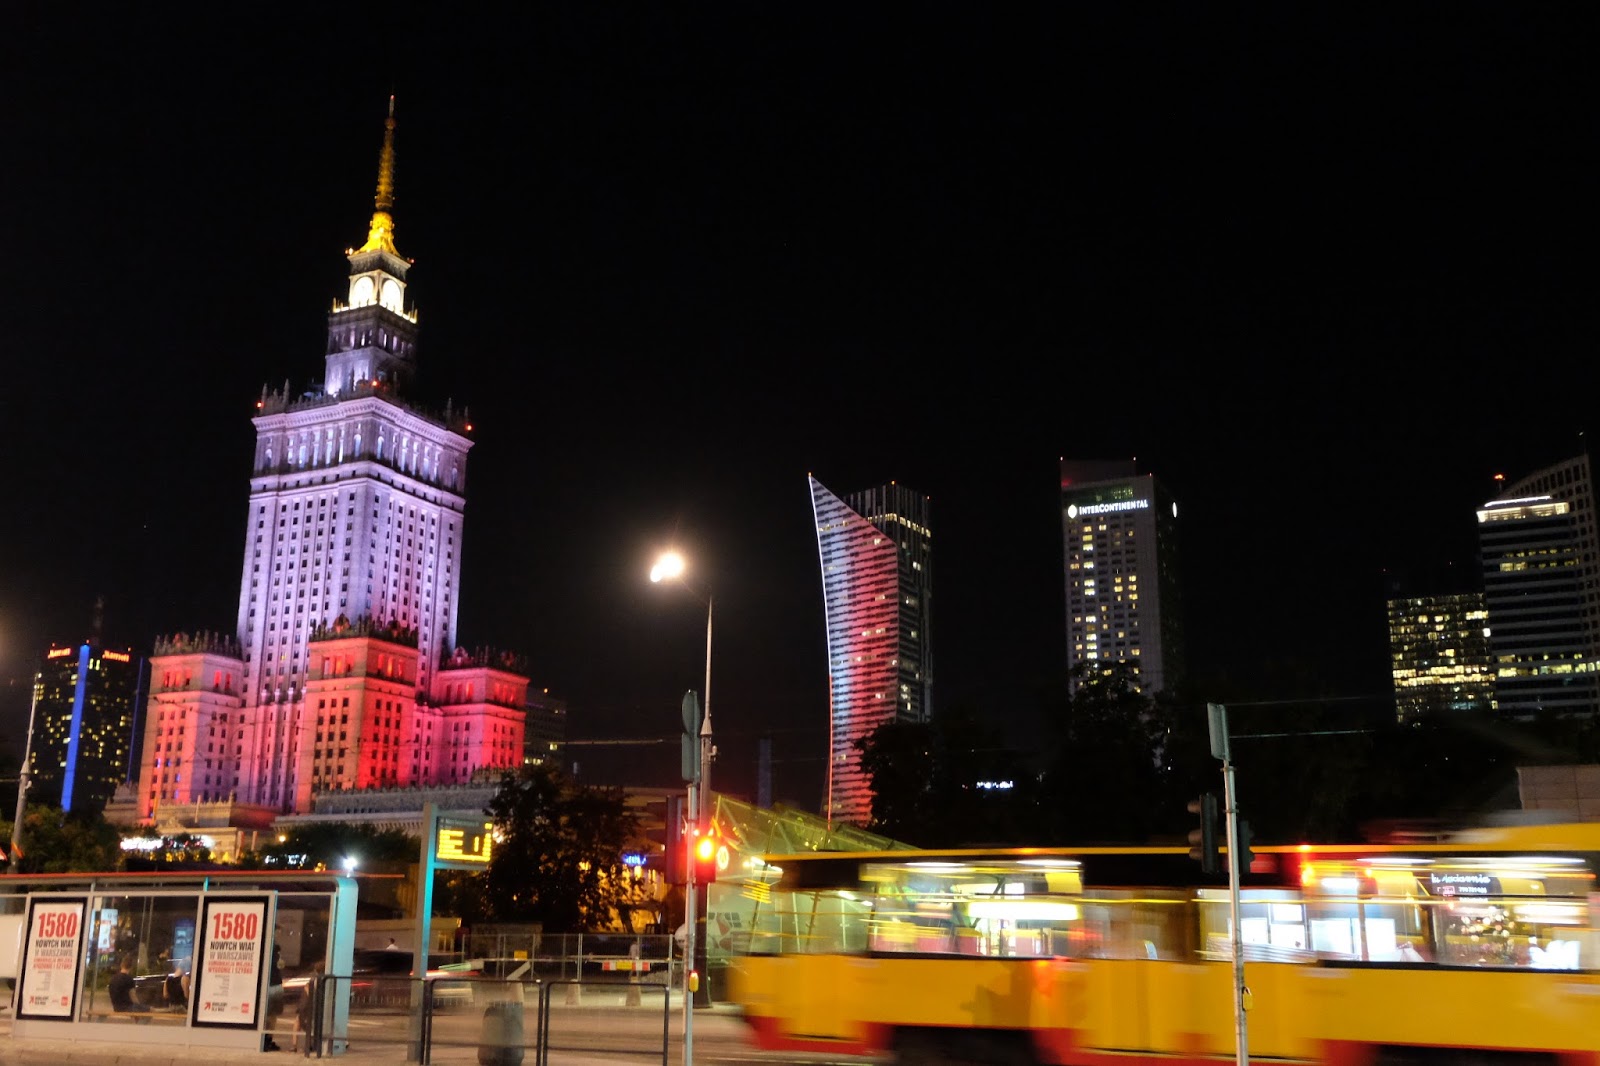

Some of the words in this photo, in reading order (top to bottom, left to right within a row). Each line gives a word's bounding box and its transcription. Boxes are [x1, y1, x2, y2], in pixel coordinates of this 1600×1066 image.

[39, 912, 78, 938] 1580
[213, 912, 258, 940] 1580
[35, 939, 58, 948] NOWYCH
[60, 939, 74, 948] WIAT
[210, 941, 237, 951] NOWYCH
[239, 942, 255, 951] WIAT
[217, 951, 254, 961] WARSZAWIE
